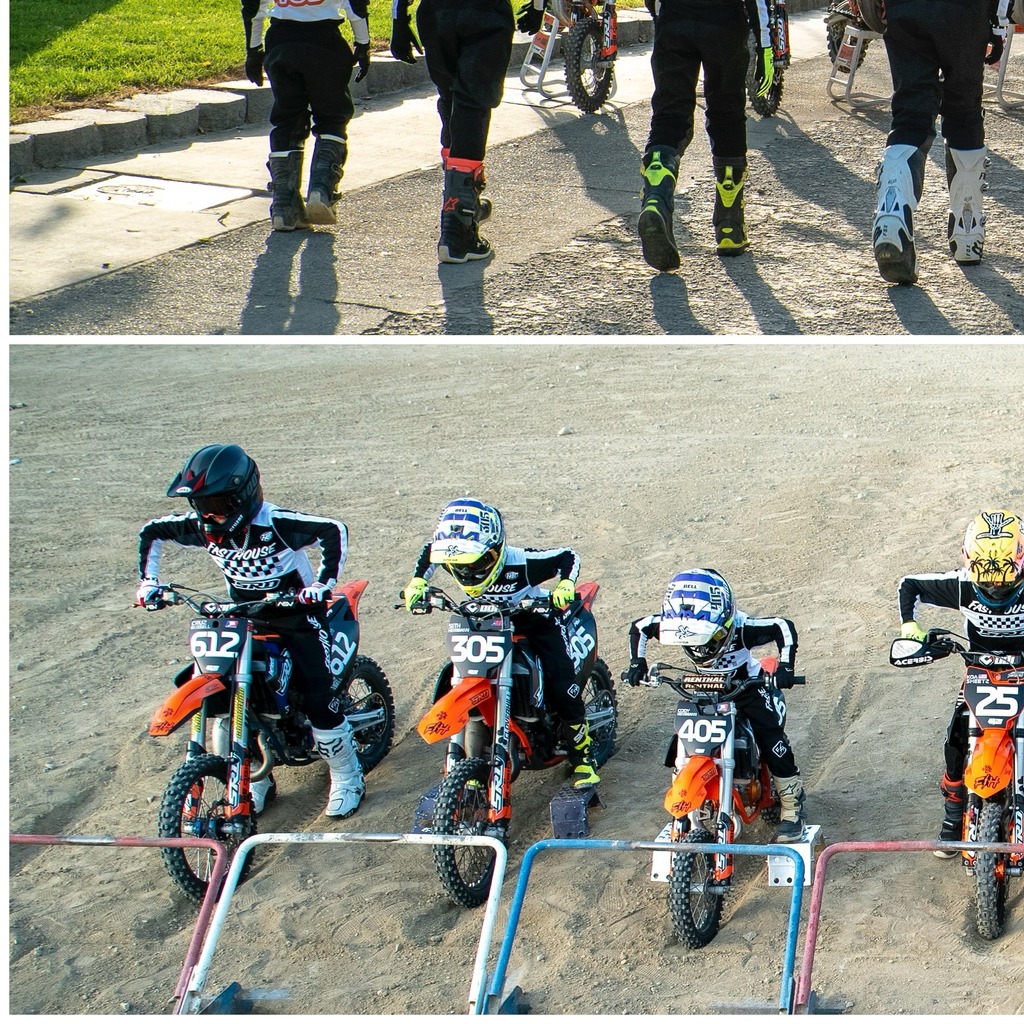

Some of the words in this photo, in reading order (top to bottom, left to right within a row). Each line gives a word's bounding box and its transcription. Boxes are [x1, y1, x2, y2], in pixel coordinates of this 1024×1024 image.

[207, 542, 276, 561] FASTHOUSE
[190, 631, 240, 657] 612
[331, 631, 355, 675] 612
[451, 635, 505, 663] 305
[894, 656, 933, 665] ACERBIS
[975, 686, 1019, 717] 25
[678, 719, 727, 743] 405
